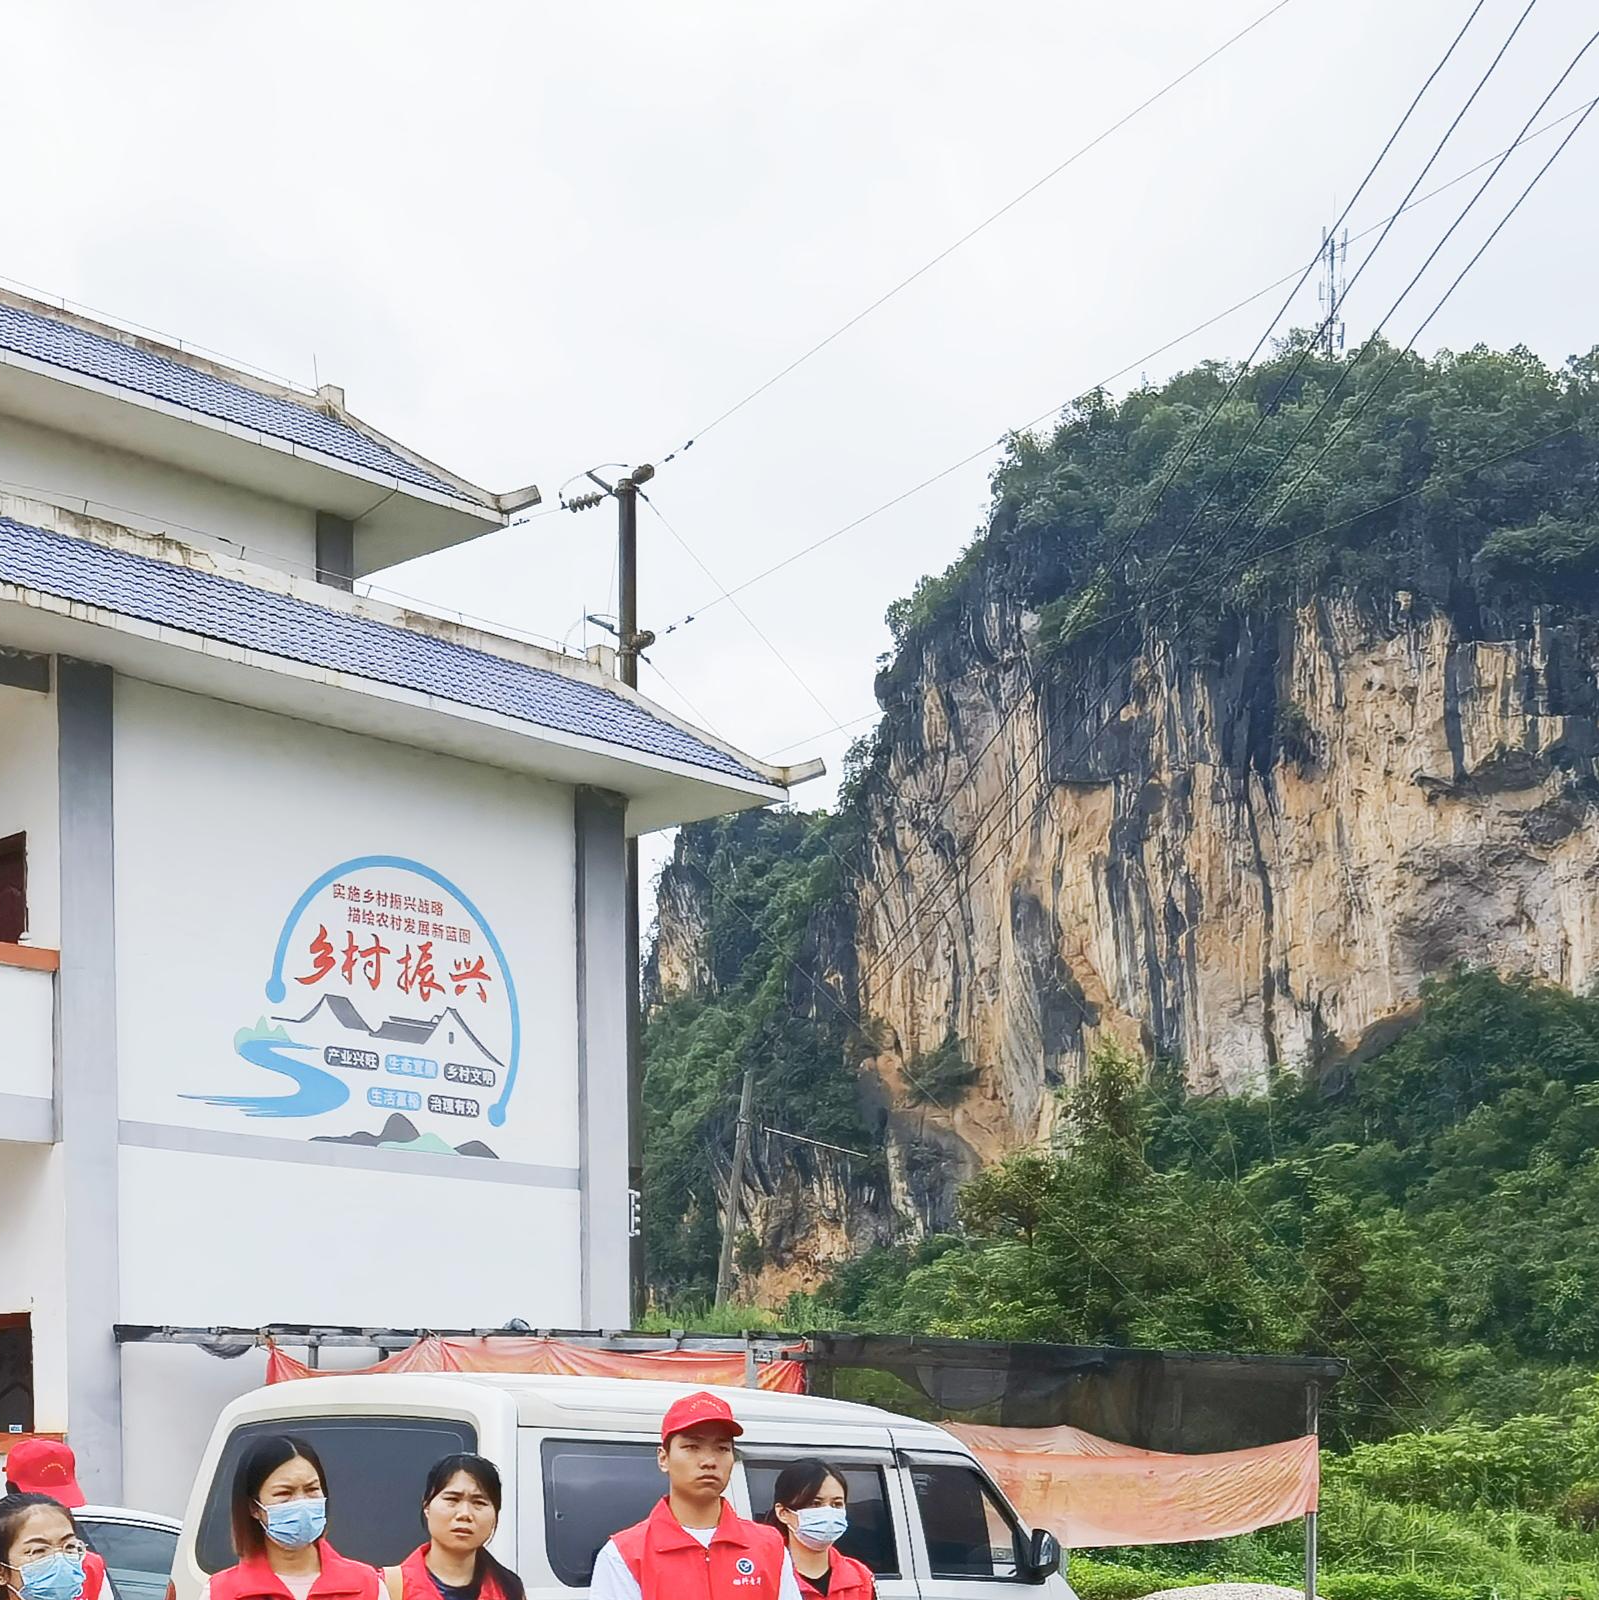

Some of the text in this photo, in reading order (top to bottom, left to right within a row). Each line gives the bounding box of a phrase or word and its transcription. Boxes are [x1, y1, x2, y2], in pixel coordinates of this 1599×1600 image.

[333, 883, 444, 916] 实施乡村振兴战略
[347, 907, 471, 944] 描绘农村发展新蓝图
[294, 924, 492, 1003] 乡村振兴
[327, 1048, 378, 1070] 产业兴旺
[430, 1096, 479, 1117] 治理有效
